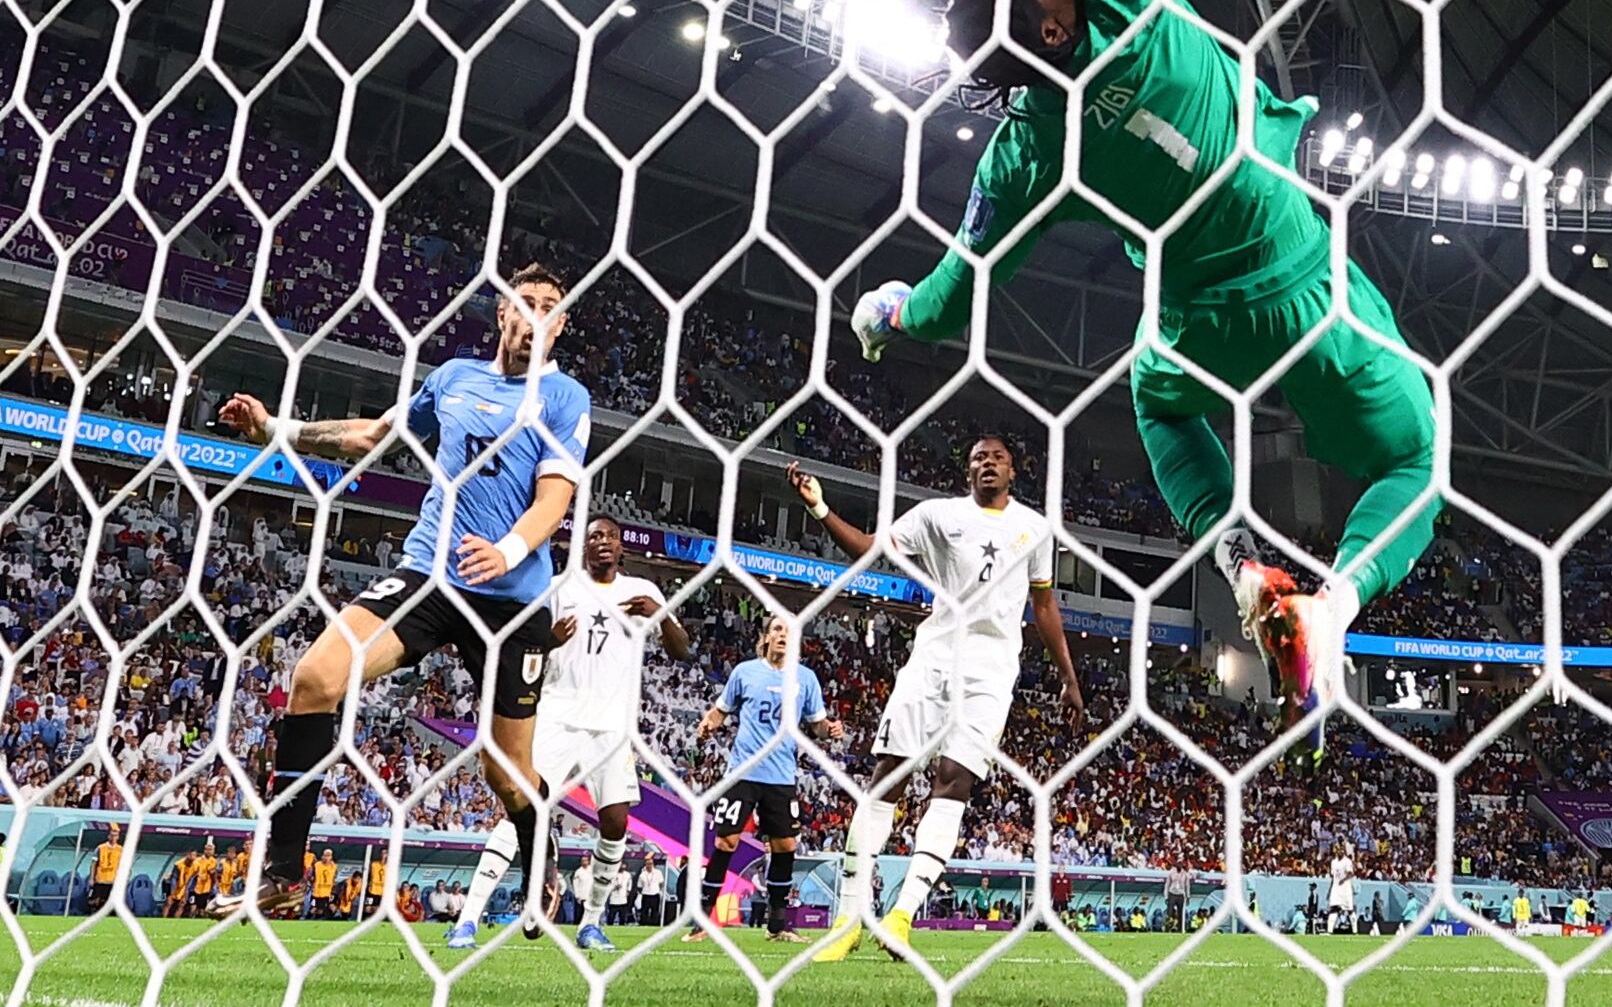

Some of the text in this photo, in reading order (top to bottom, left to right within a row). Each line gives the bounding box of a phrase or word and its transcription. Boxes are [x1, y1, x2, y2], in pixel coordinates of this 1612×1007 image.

[1083, 85, 1135, 130] ZIGI
[1124, 108, 1199, 173] 1
[76, 421, 110, 442] CUP
[623, 530, 650, 545] 88:10
[746, 554, 784, 572] WORLD
[786, 561, 807, 576] CUP
[587, 629, 609, 655] 17
[1395, 641, 1419, 654] FIFA
[1419, 642, 1460, 656] WORLD
[1461, 645, 1484, 657] CUP
[878, 719, 891, 748] 4
[714, 797, 742, 825] 24
